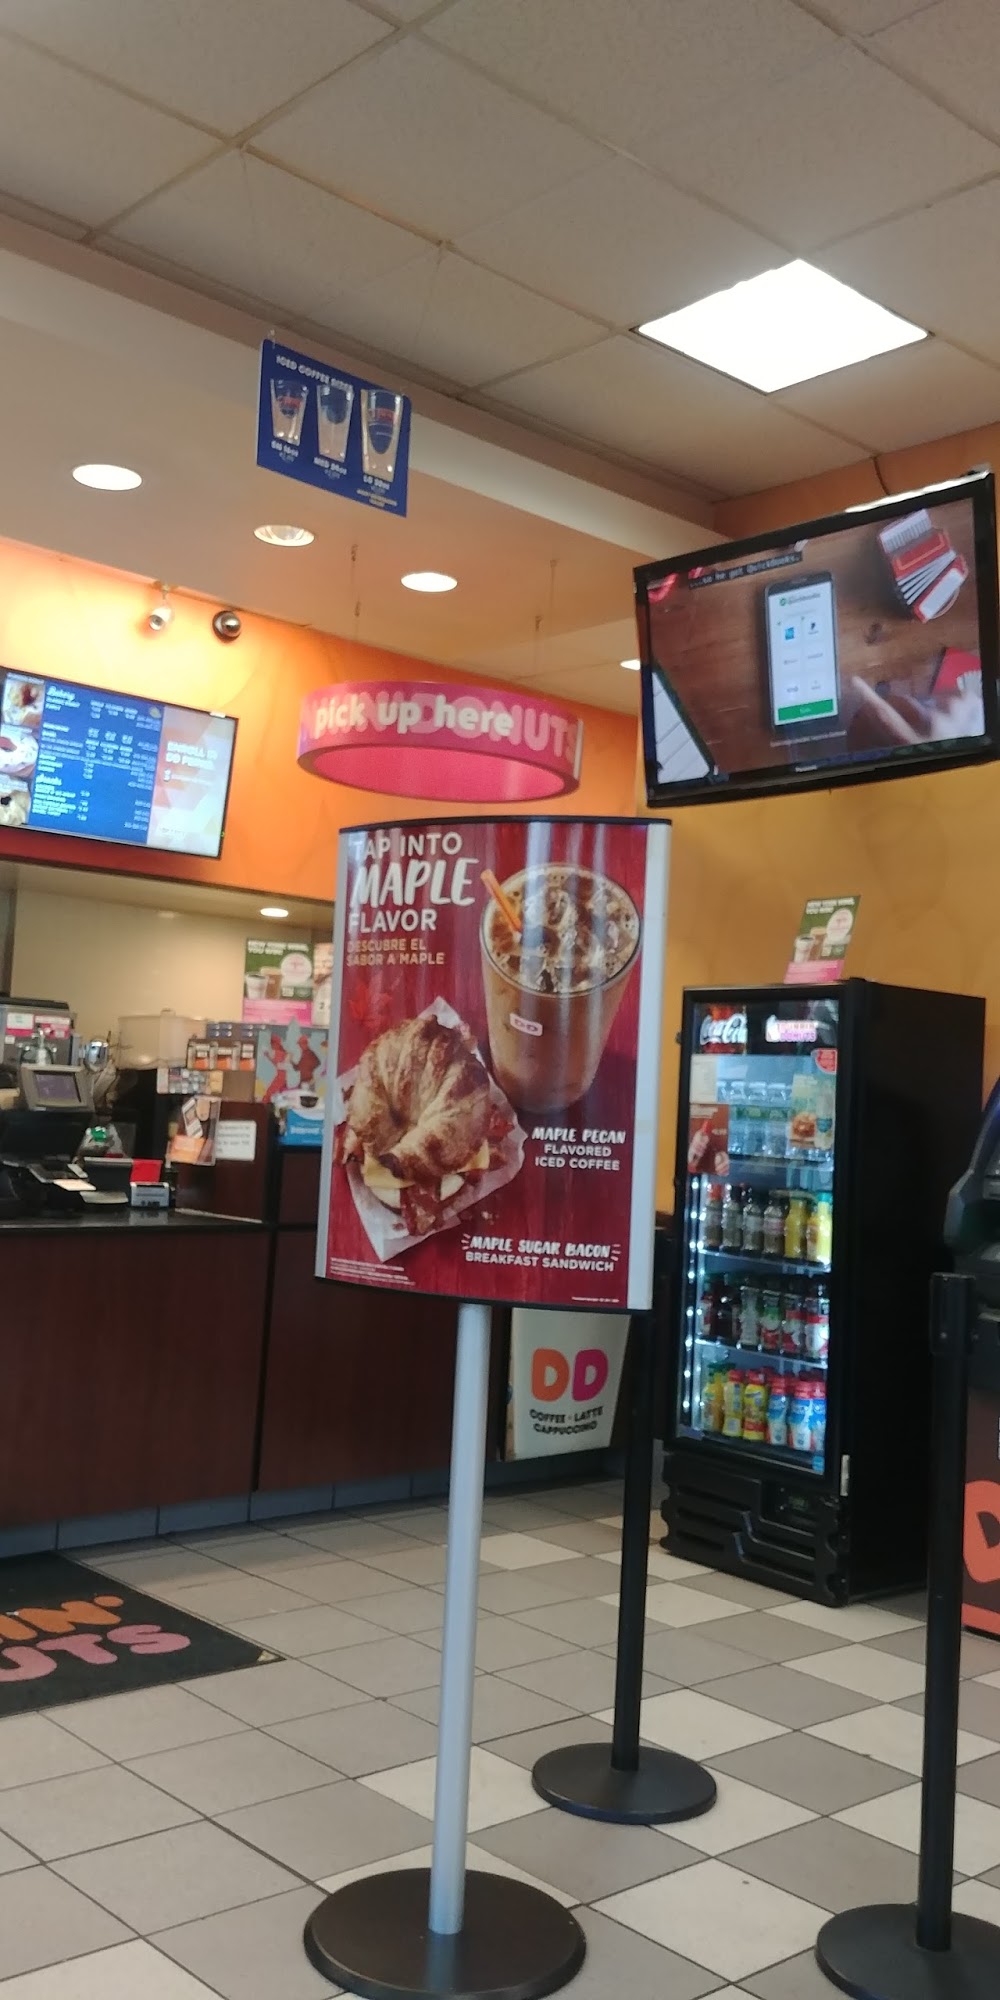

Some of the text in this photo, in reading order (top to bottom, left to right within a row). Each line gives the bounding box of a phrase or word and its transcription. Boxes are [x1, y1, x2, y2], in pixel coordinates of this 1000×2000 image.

[276, 355, 297, 370] ICED
[298, 365, 331, 384] COFFEE
[314, 694, 514, 739] pick up here
[352, 831, 462, 861] TAP INTO
[350, 857, 479, 908] MAPLE
[348, 908, 437, 933] FLAVOR
[347, 938, 426, 952] DESCUBRE EL
[346, 953, 383, 966] SABOR
[387, 953, 396, 965] A
[399, 952, 445, 965] MAPLE
[531, 1127, 626, 1144] MAPLE PECAN
[544, 1144, 612, 1157] FLAVORED
[535, 1156, 620, 1171] ICED COFFEE
[470, 1236, 611, 1258] MAPLE SUGAR BACON
[465, 1251, 614, 1272] BREAKFAST SANDWICH
[530, 1347, 609, 1402] DD
[530, 1405, 604, 1424] COFFEE LATTE
[533, 1420, 598, 1435] CAPPUCCINO
